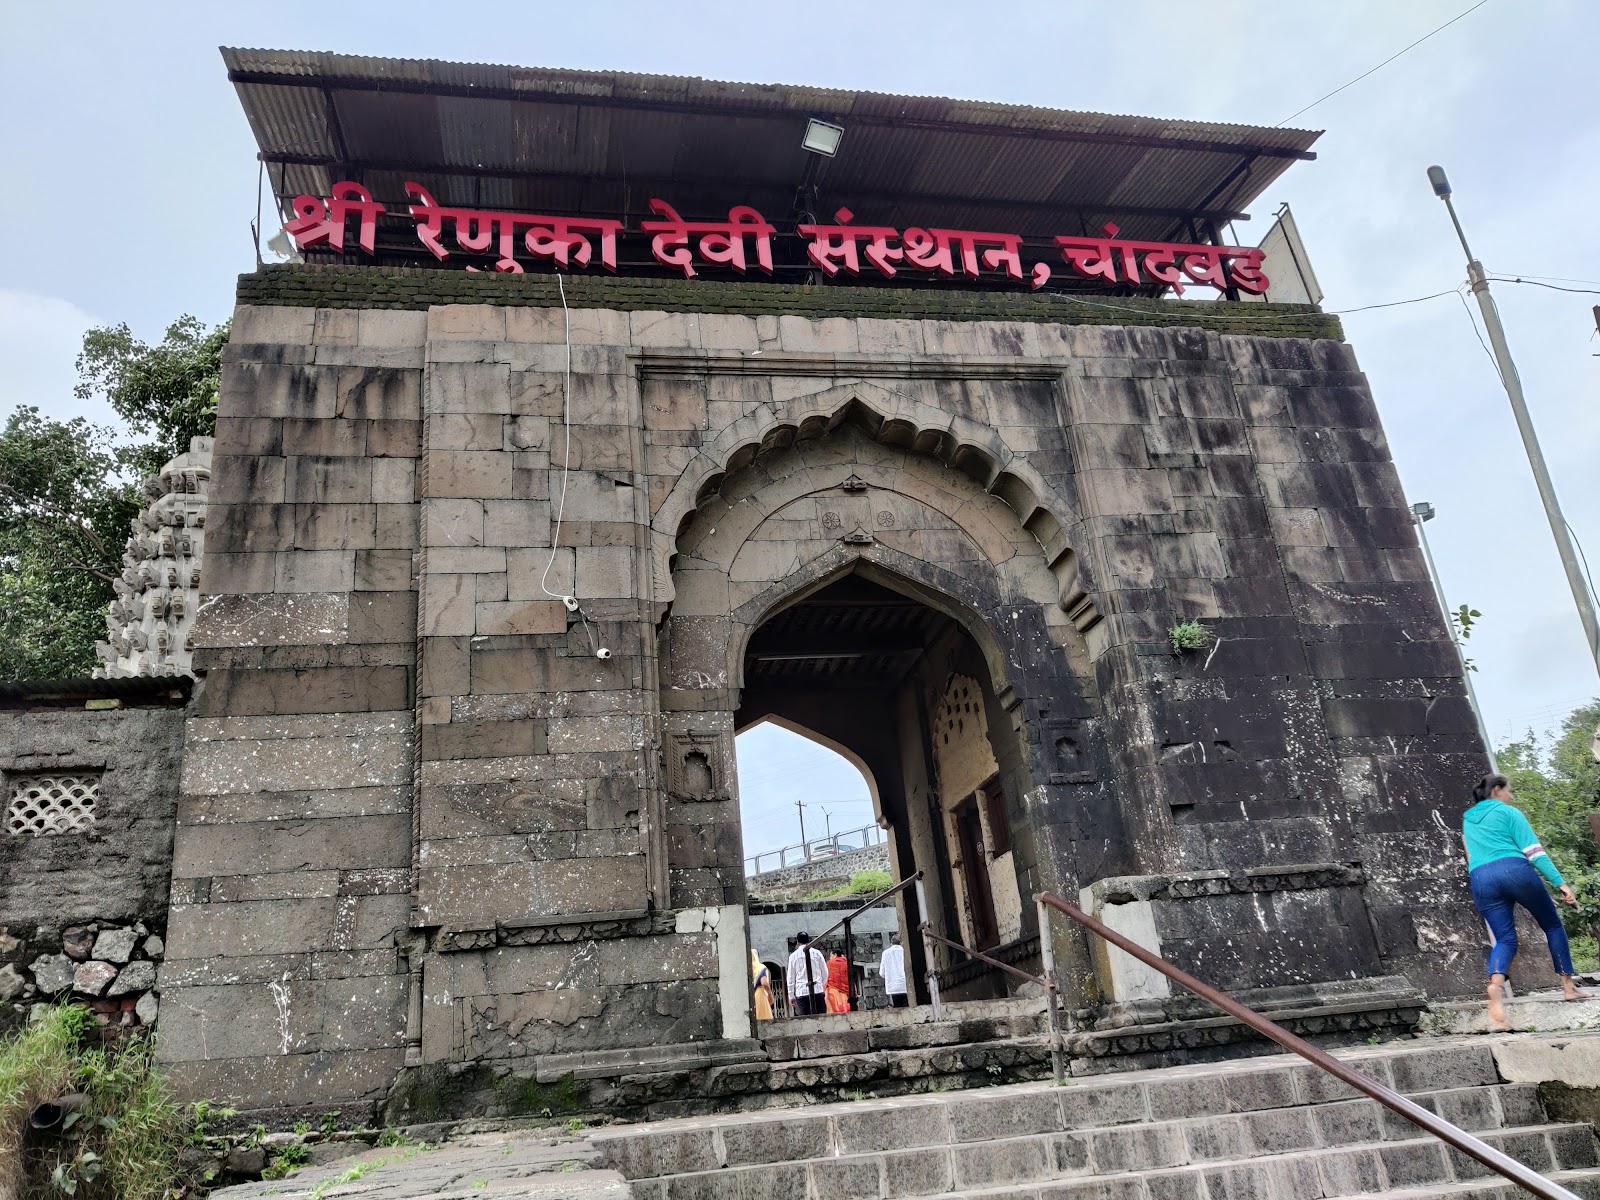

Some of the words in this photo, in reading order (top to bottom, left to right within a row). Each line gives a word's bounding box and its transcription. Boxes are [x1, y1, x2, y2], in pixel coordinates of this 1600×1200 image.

[285, 180, 386, 255] श्री
[641, 198, 777, 279] देवी
[1053, 221, 1268, 296] चांदवड
